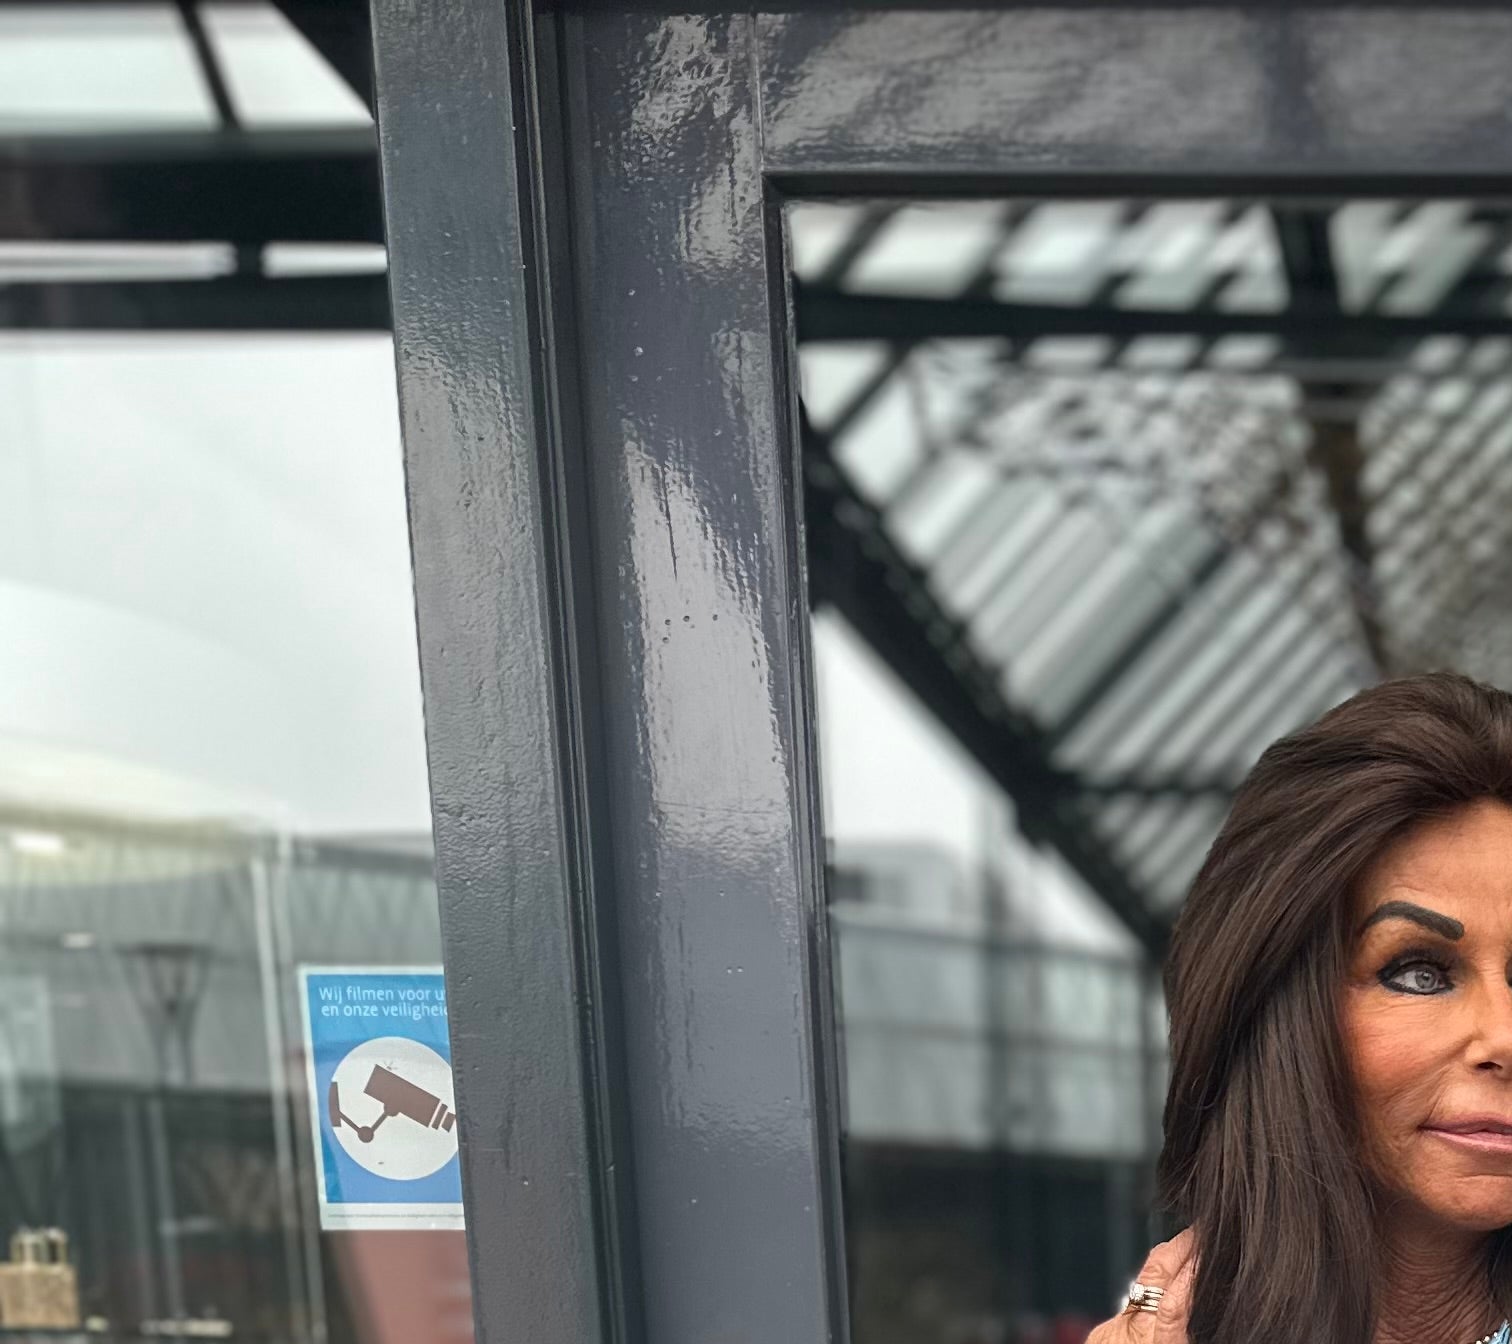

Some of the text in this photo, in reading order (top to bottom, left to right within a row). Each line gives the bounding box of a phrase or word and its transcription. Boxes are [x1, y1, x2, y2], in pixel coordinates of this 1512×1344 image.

[318, 986, 342, 1004] Wij
[346, 985, 394, 1001] filmen
[398, 989, 431, 1001] voor
[321, 1004, 339, 1017] en
[343, 1004, 378, 1017] onze
